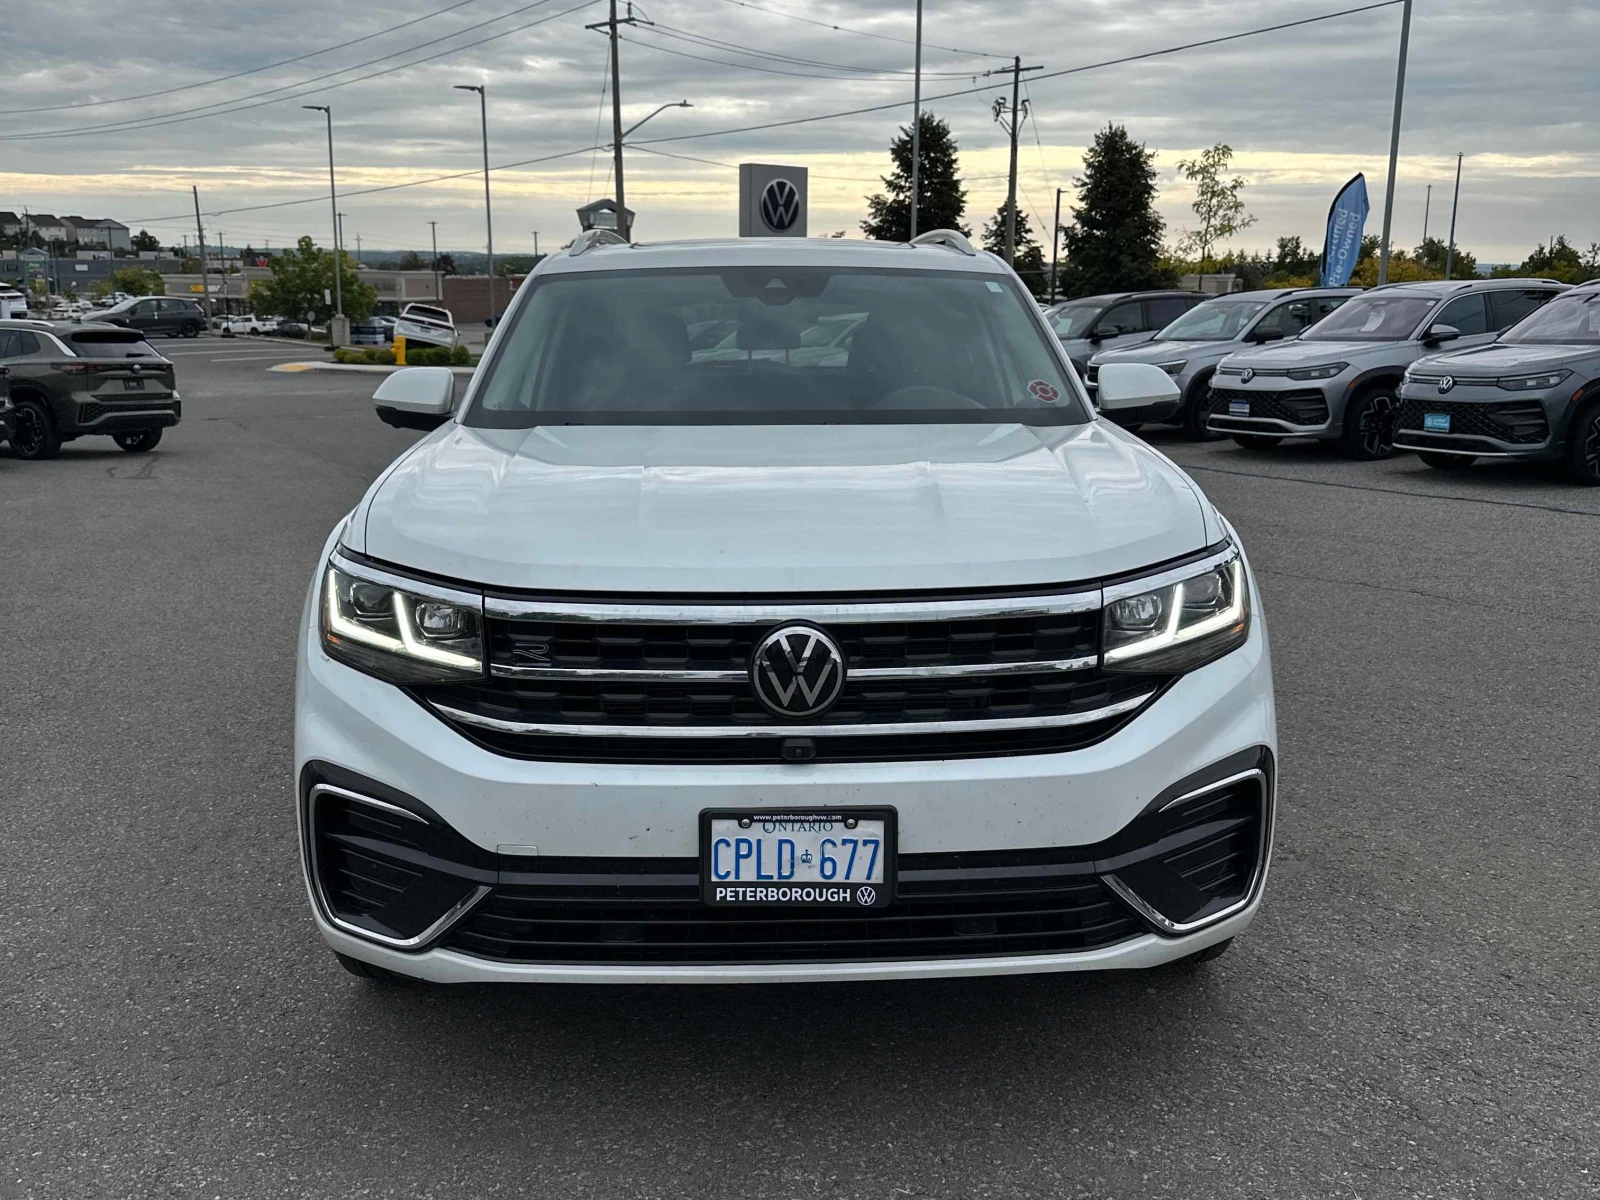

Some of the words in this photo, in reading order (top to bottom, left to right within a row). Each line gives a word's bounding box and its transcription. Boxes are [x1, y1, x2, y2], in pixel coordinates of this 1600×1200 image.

[1328, 208, 1348, 264] tified
[1329, 212, 1360, 286] Pre-Owned
[753, 626, 843, 717] VW
[753, 814, 842, 822] www.peterboroughvw.com
[762, 821, 834, 834] ONTARIO
[713, 837, 796, 880] CPLD
[819, 837, 880, 881] 677
[716, 887, 851, 902] PETERBOROUGH
